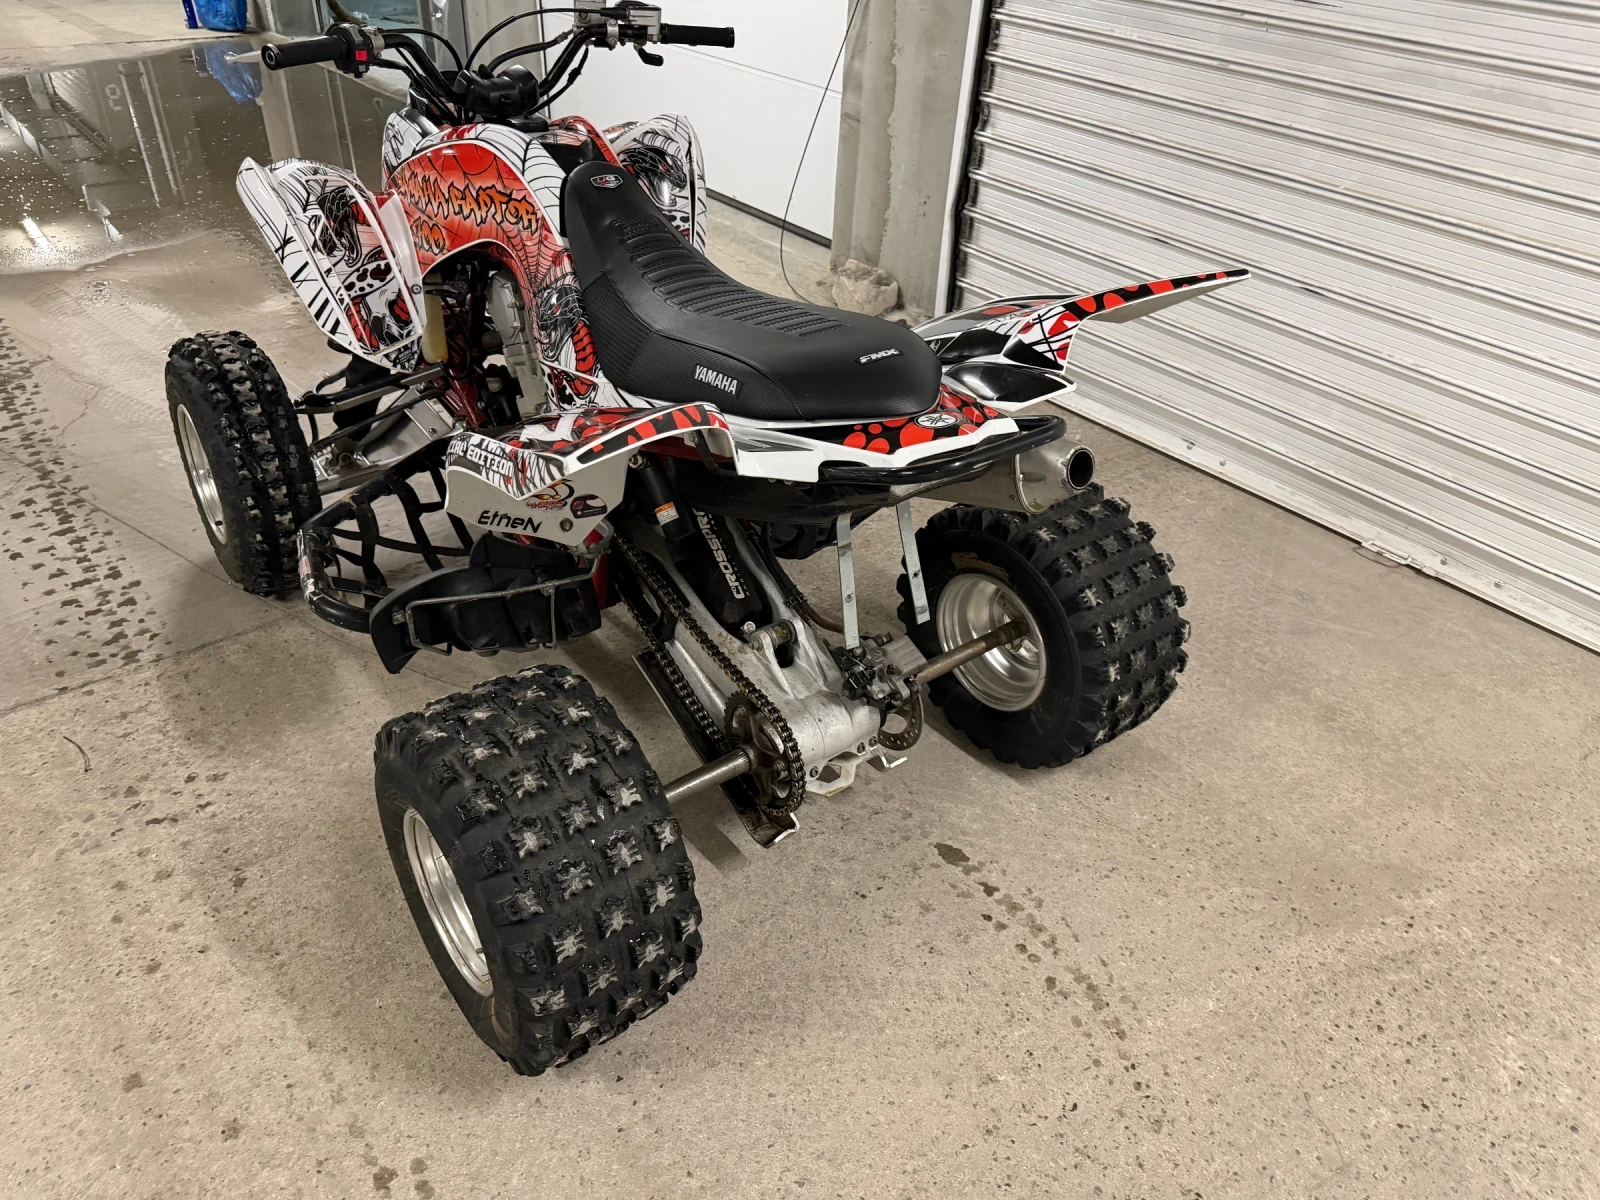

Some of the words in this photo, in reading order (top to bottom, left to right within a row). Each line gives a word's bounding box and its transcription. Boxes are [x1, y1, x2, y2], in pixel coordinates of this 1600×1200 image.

[397, 168, 449, 220] AMAHA
[448, 181, 539, 236] RAPTOR
[694, 363, 738, 395] YAMAHA
[466, 445, 514, 478] EDITION
